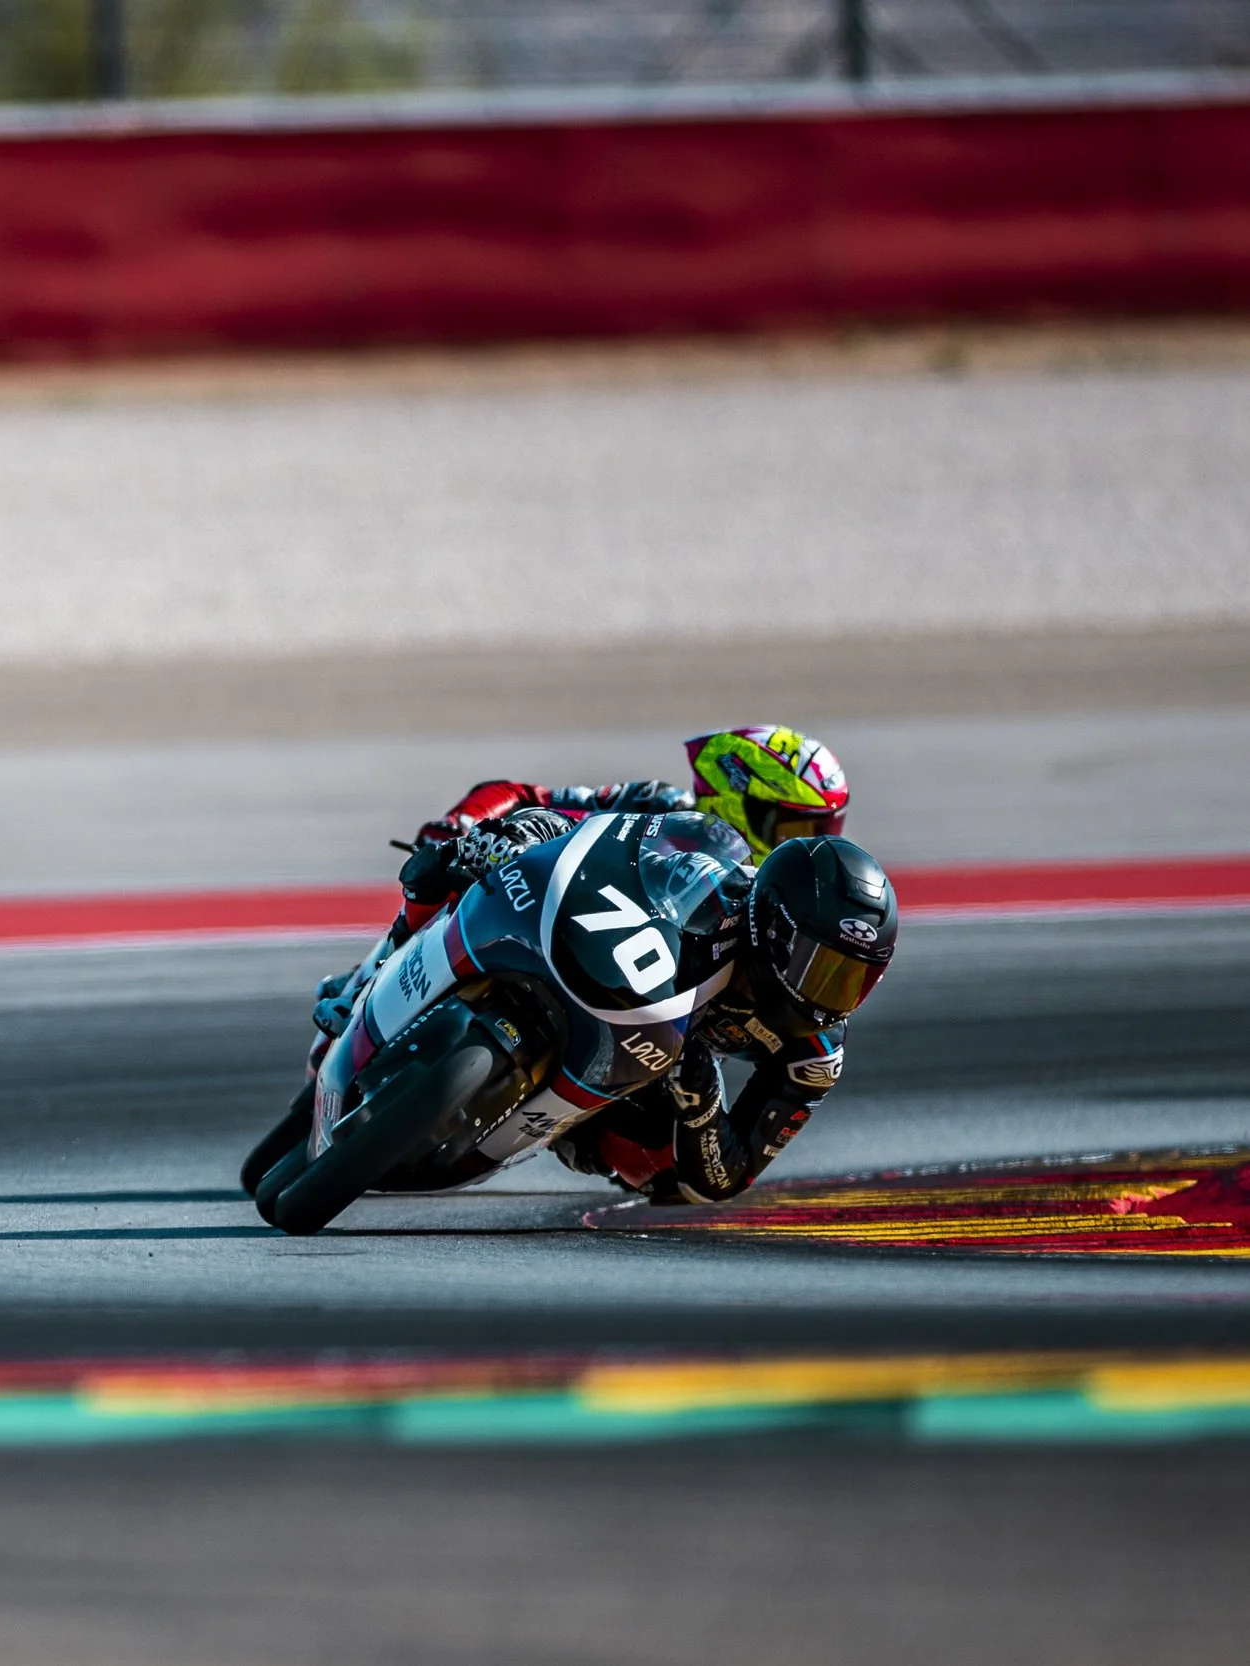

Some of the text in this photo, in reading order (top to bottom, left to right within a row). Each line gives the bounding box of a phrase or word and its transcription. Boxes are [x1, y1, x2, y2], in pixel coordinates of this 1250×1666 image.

[498, 860, 536, 912] LAZU
[571, 884, 677, 995] 70
[388, 1003, 443, 1048] PIRELLI
[620, 1031, 674, 1073] LAZU
[475, 1093, 526, 1144] PIRELLI
